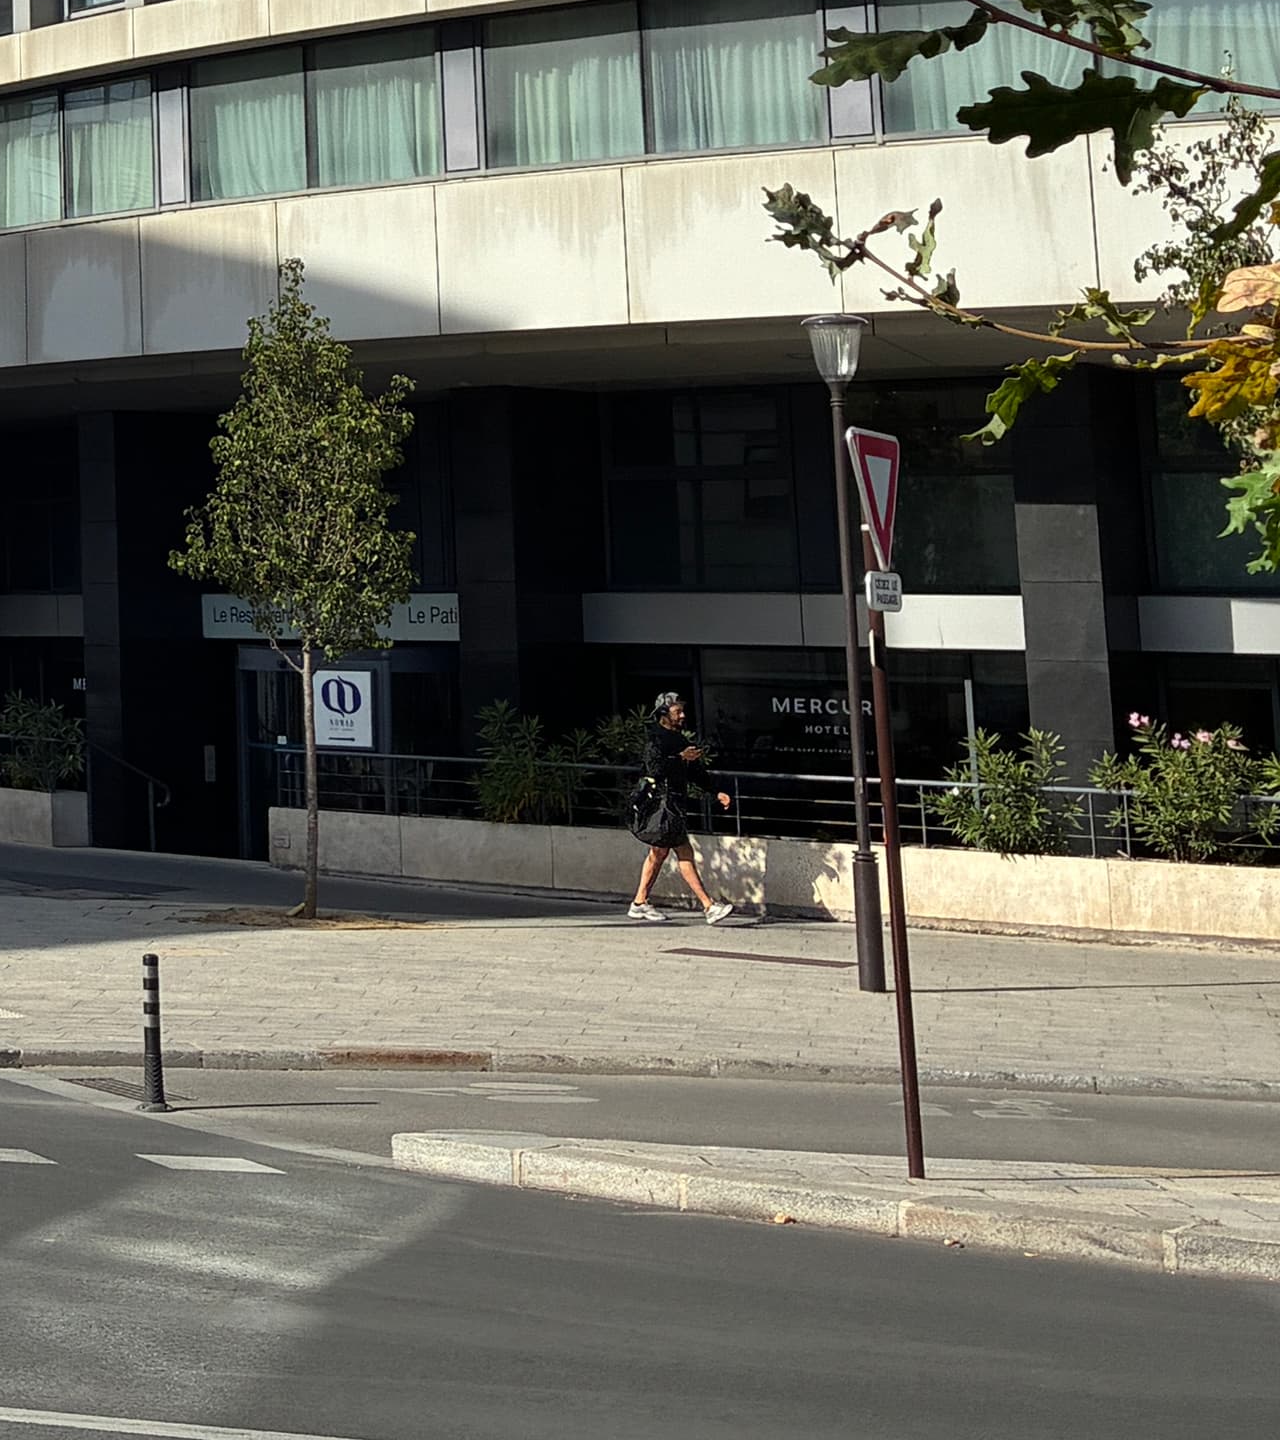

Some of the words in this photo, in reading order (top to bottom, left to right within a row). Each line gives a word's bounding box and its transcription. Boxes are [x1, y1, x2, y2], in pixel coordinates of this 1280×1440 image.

[213, 606, 227, 623] Le
[408, 606, 425, 624] Le
[430, 605, 458, 624] Pati
[771, 696, 873, 716] MERCUR
